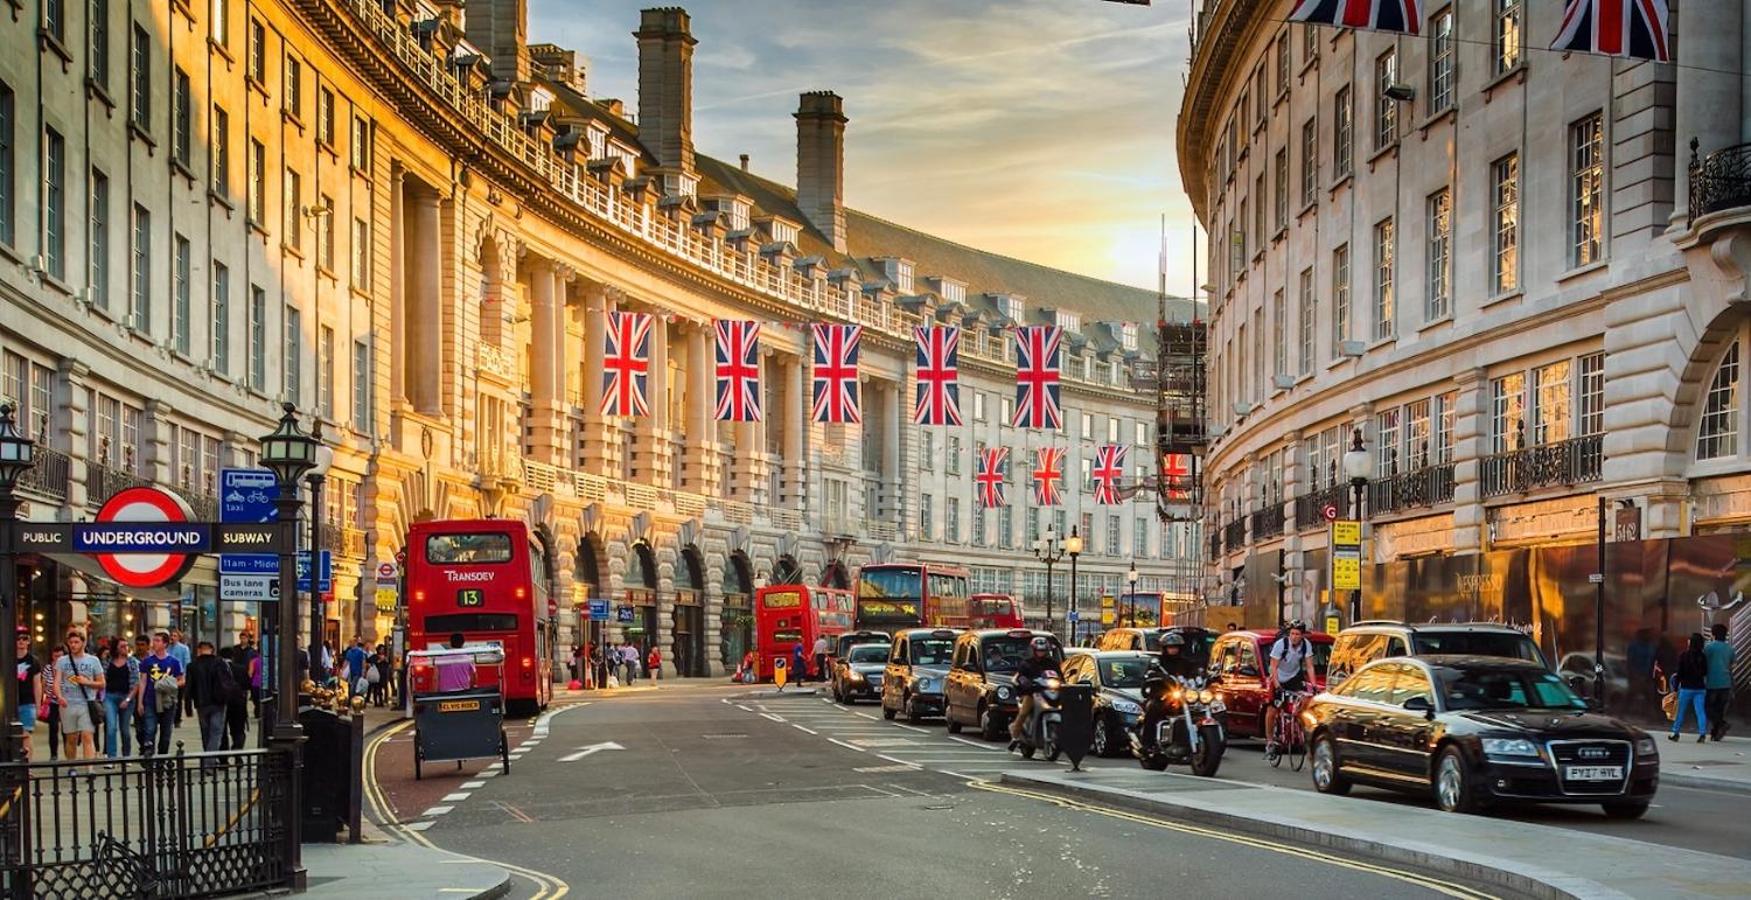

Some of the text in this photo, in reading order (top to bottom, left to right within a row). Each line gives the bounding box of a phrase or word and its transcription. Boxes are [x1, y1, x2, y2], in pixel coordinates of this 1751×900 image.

[226, 503, 244, 512] taxi
[1326, 506, 1336, 518] G
[23, 531, 272, 545] PUBLIC UNDERGROUND SUBWAY
[224, 559, 246, 567] 11am
[224, 579, 264, 587] Bus lane
[224, 590, 264, 598] cameras
[463, 590, 478, 605] 13
